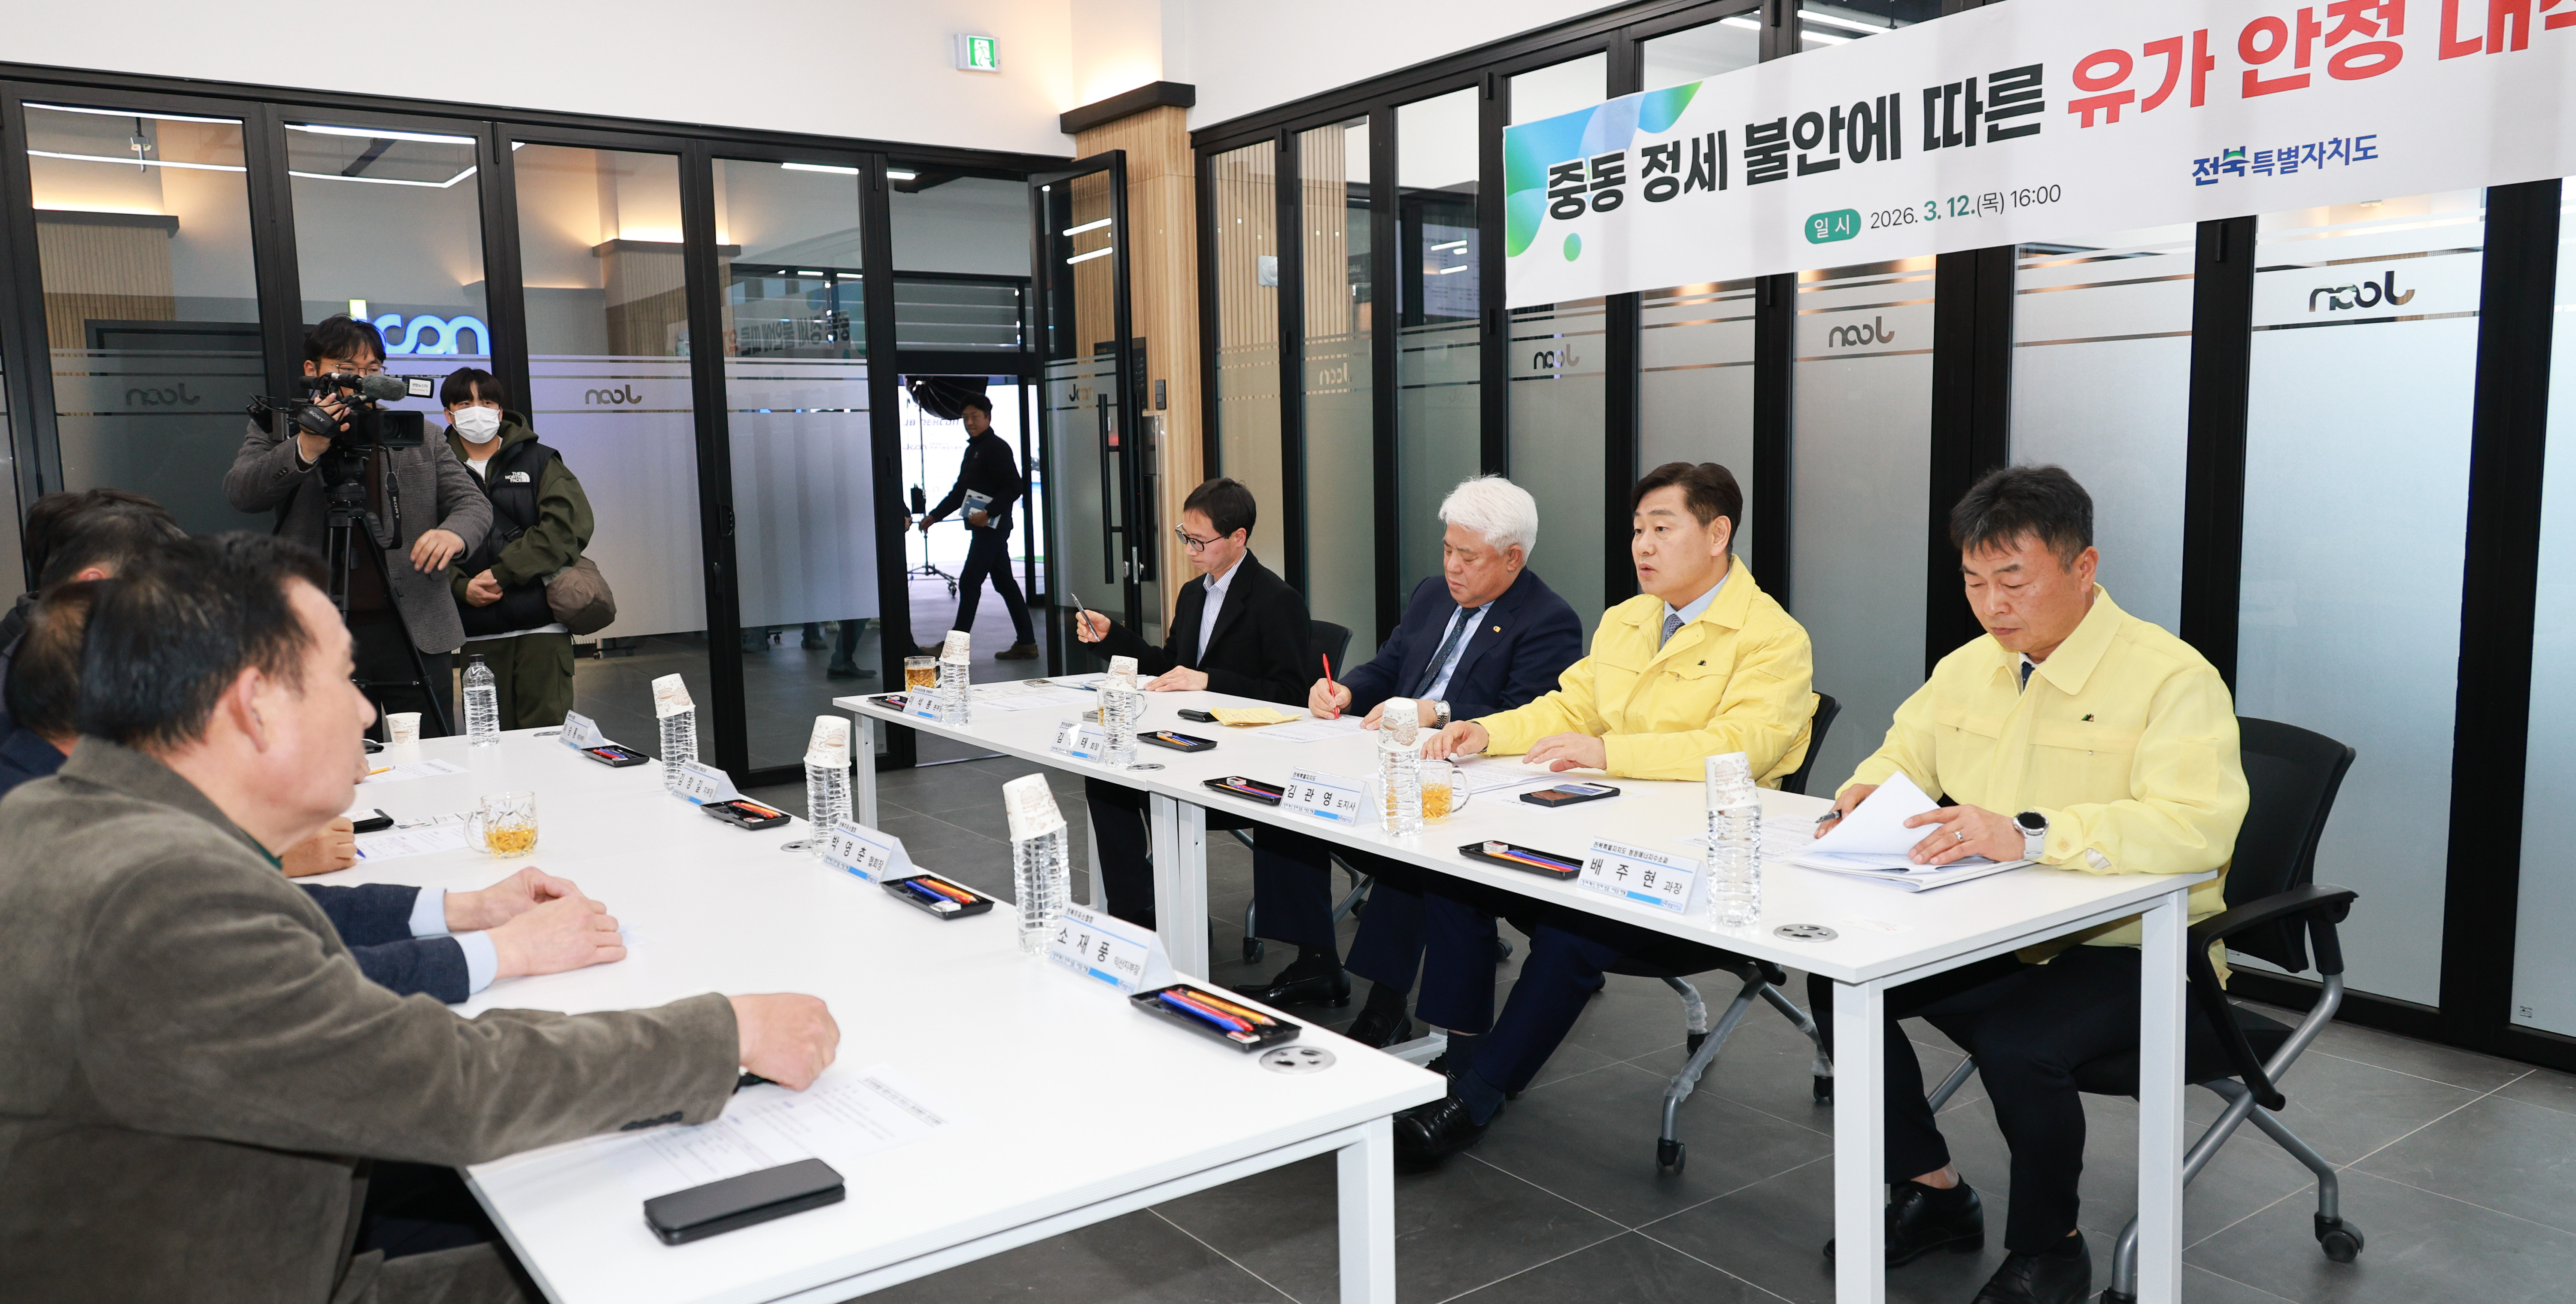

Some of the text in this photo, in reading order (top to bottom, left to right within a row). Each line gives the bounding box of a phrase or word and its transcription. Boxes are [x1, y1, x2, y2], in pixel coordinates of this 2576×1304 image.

[1548, 0, 2576, 220] 중동 정세 불안에 따른 유가 안정 대
[2192, 134, 2379, 186] 전북특별자치도
[1870, 207, 1918, 229] 2026.
[2011, 184, 2061, 209] 16:00
[309, 410, 325, 422] SONY
[1337, 800, 1356, 812] 도지사
[1593, 841, 1627, 854] 전북특별자치도
[868, 856, 884, 870] 협회장
[1664, 881, 1683, 895] 과장
